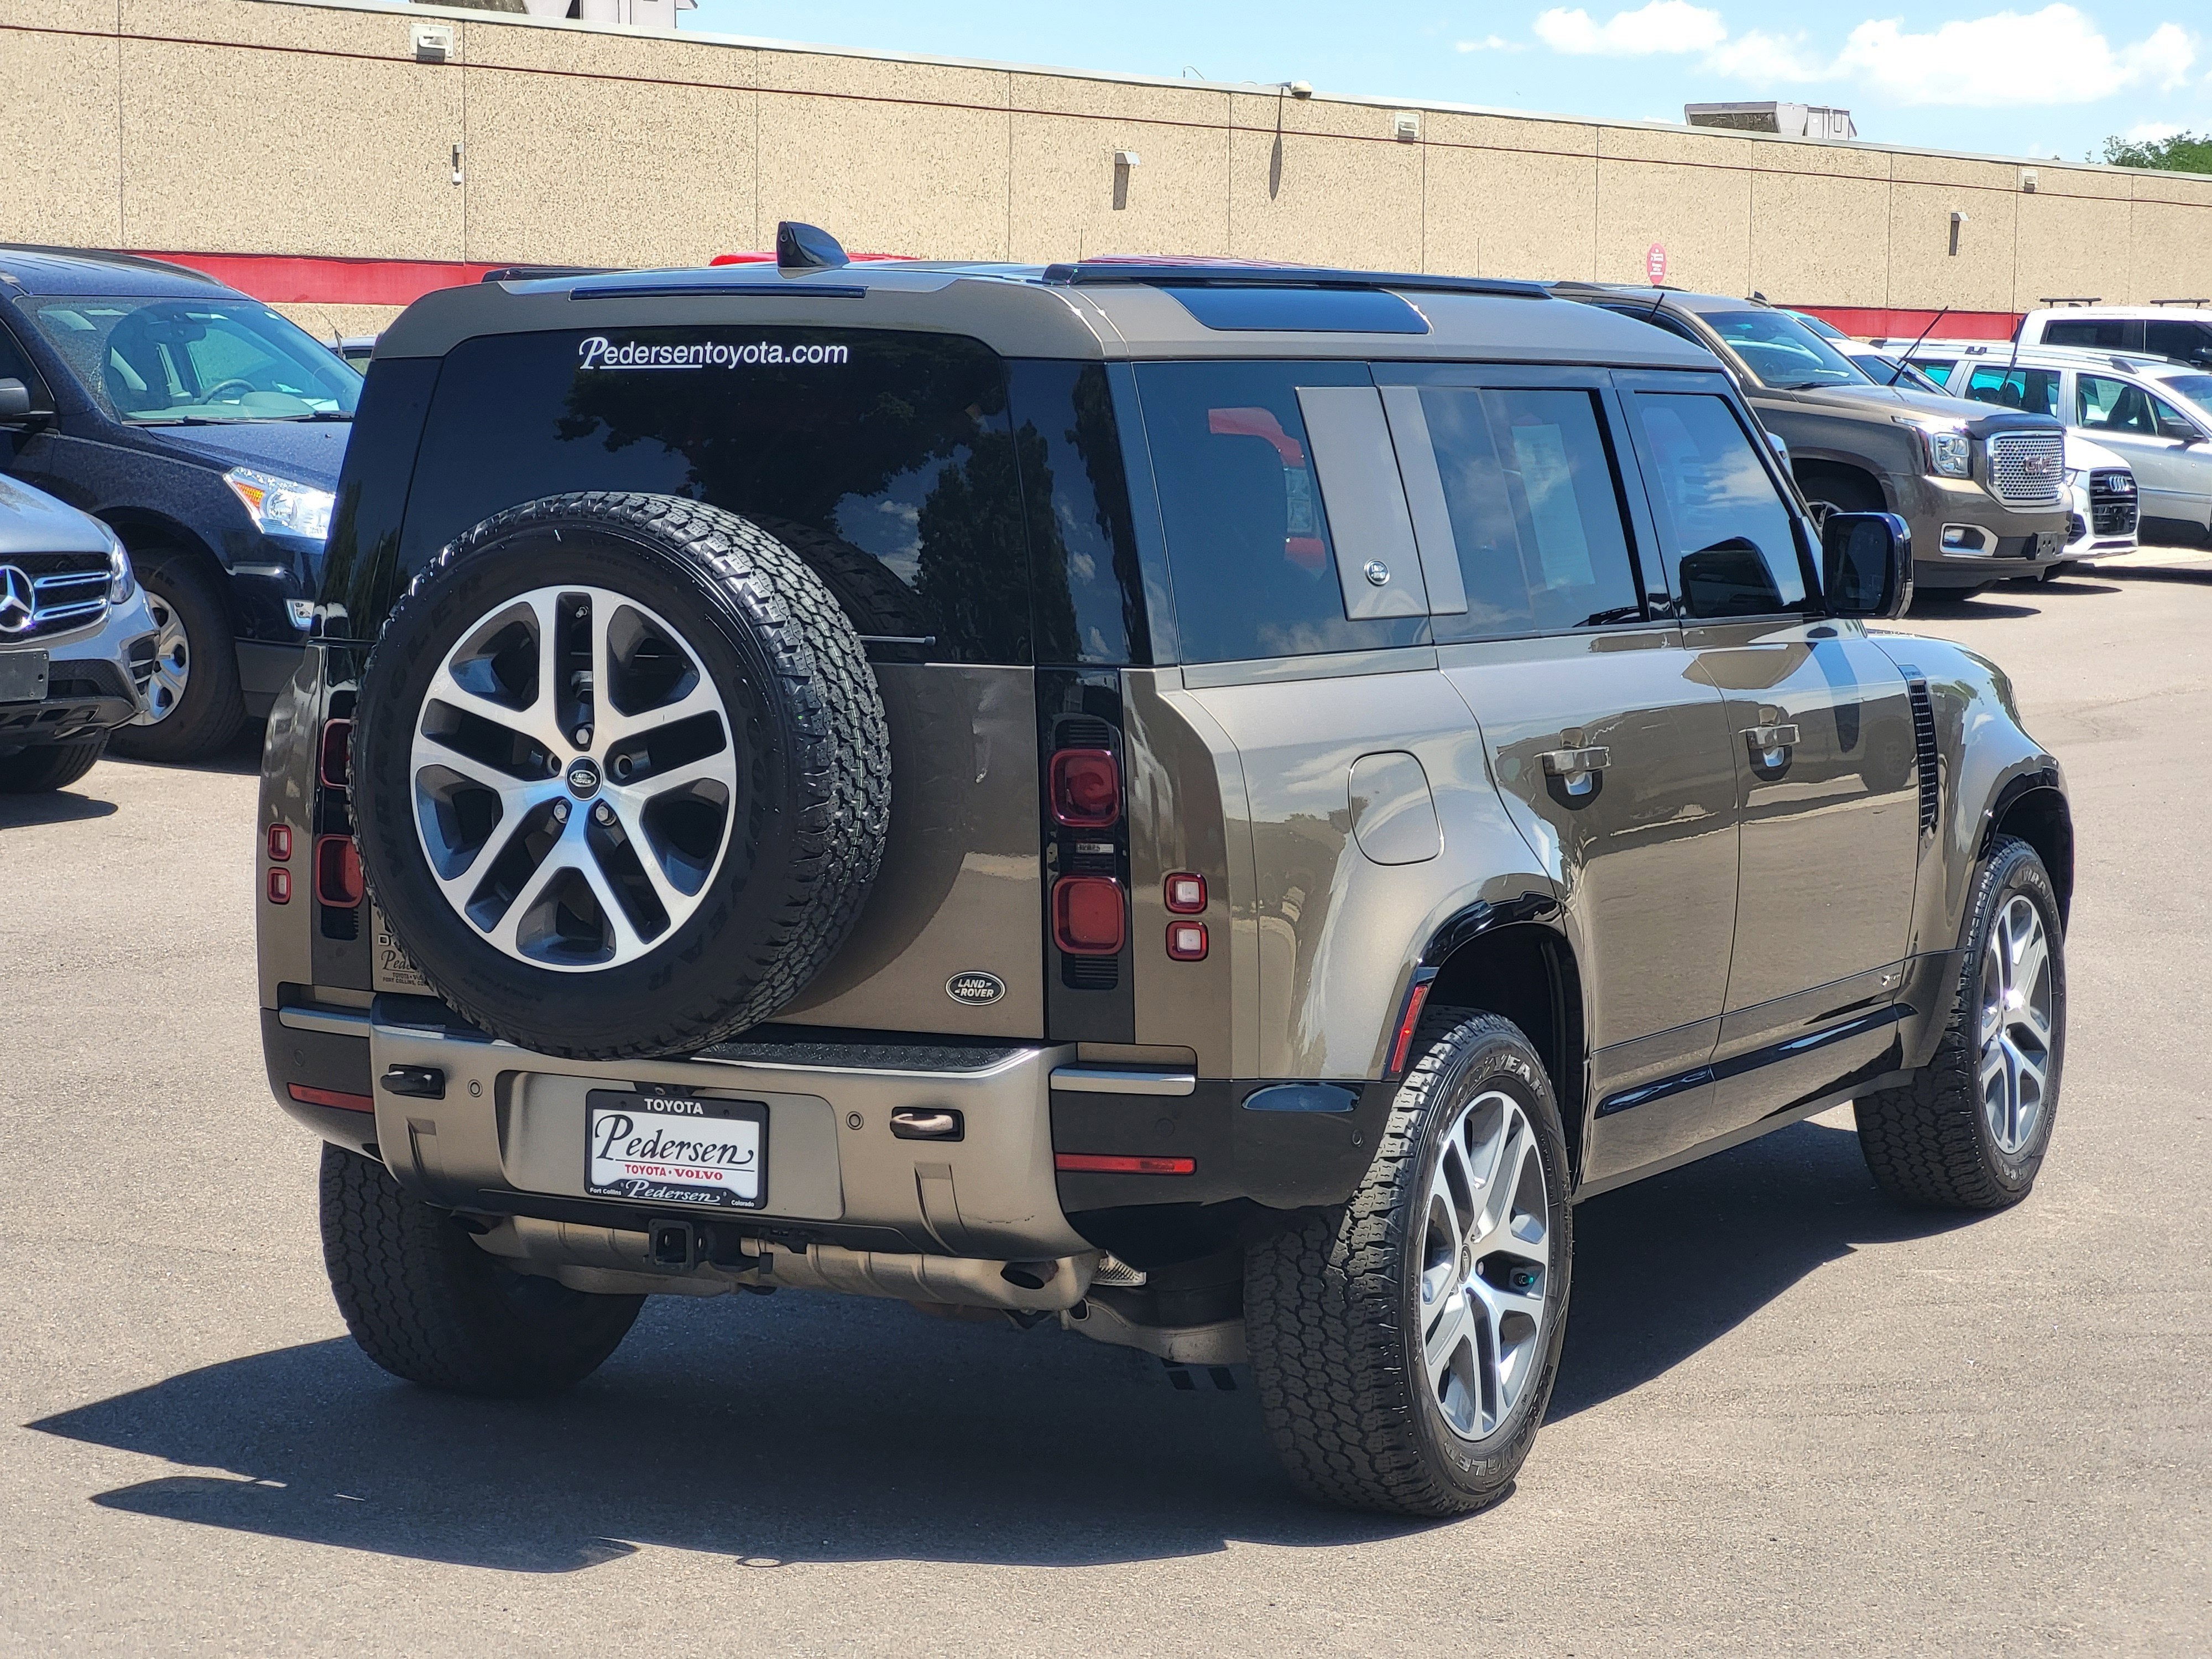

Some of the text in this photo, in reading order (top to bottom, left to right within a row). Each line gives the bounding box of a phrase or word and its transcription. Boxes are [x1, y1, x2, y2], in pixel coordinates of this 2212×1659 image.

[578, 336, 848, 370] Pedersentoyota.com
[958, 979, 985, 988] LAND
[961, 988, 994, 997] ROVER
[644, 1098, 704, 1115] TOYOTA
[594, 1114, 754, 1165] Pedersen
[624, 1164, 723, 1181] TOYOTA VOLVO
[602, 1187, 622, 1196] Collins
[625, 1179, 721, 1202] Pedersen
